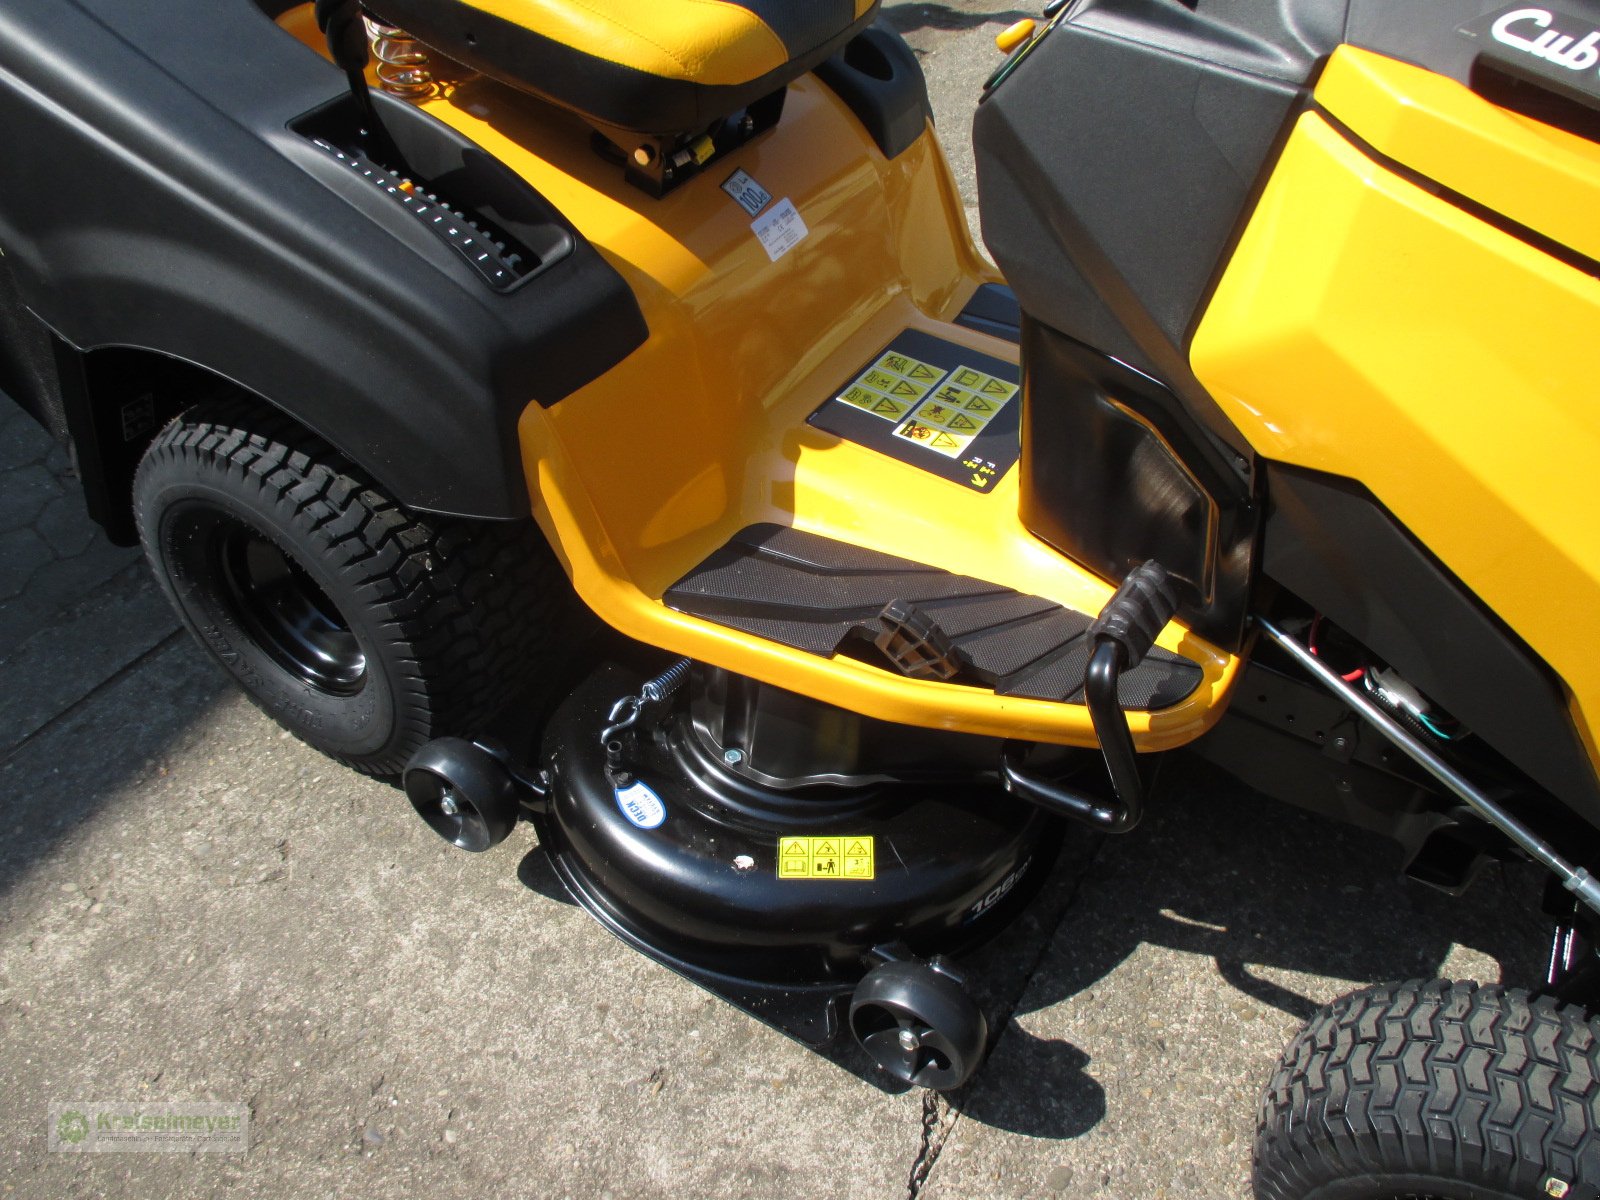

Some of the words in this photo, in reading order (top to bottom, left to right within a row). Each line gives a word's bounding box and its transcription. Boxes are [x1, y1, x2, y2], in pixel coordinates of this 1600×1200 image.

[1491, 8, 1600, 71] Cub
[740, 187, 764, 212] 100
[625, 800, 647, 822] DECK
